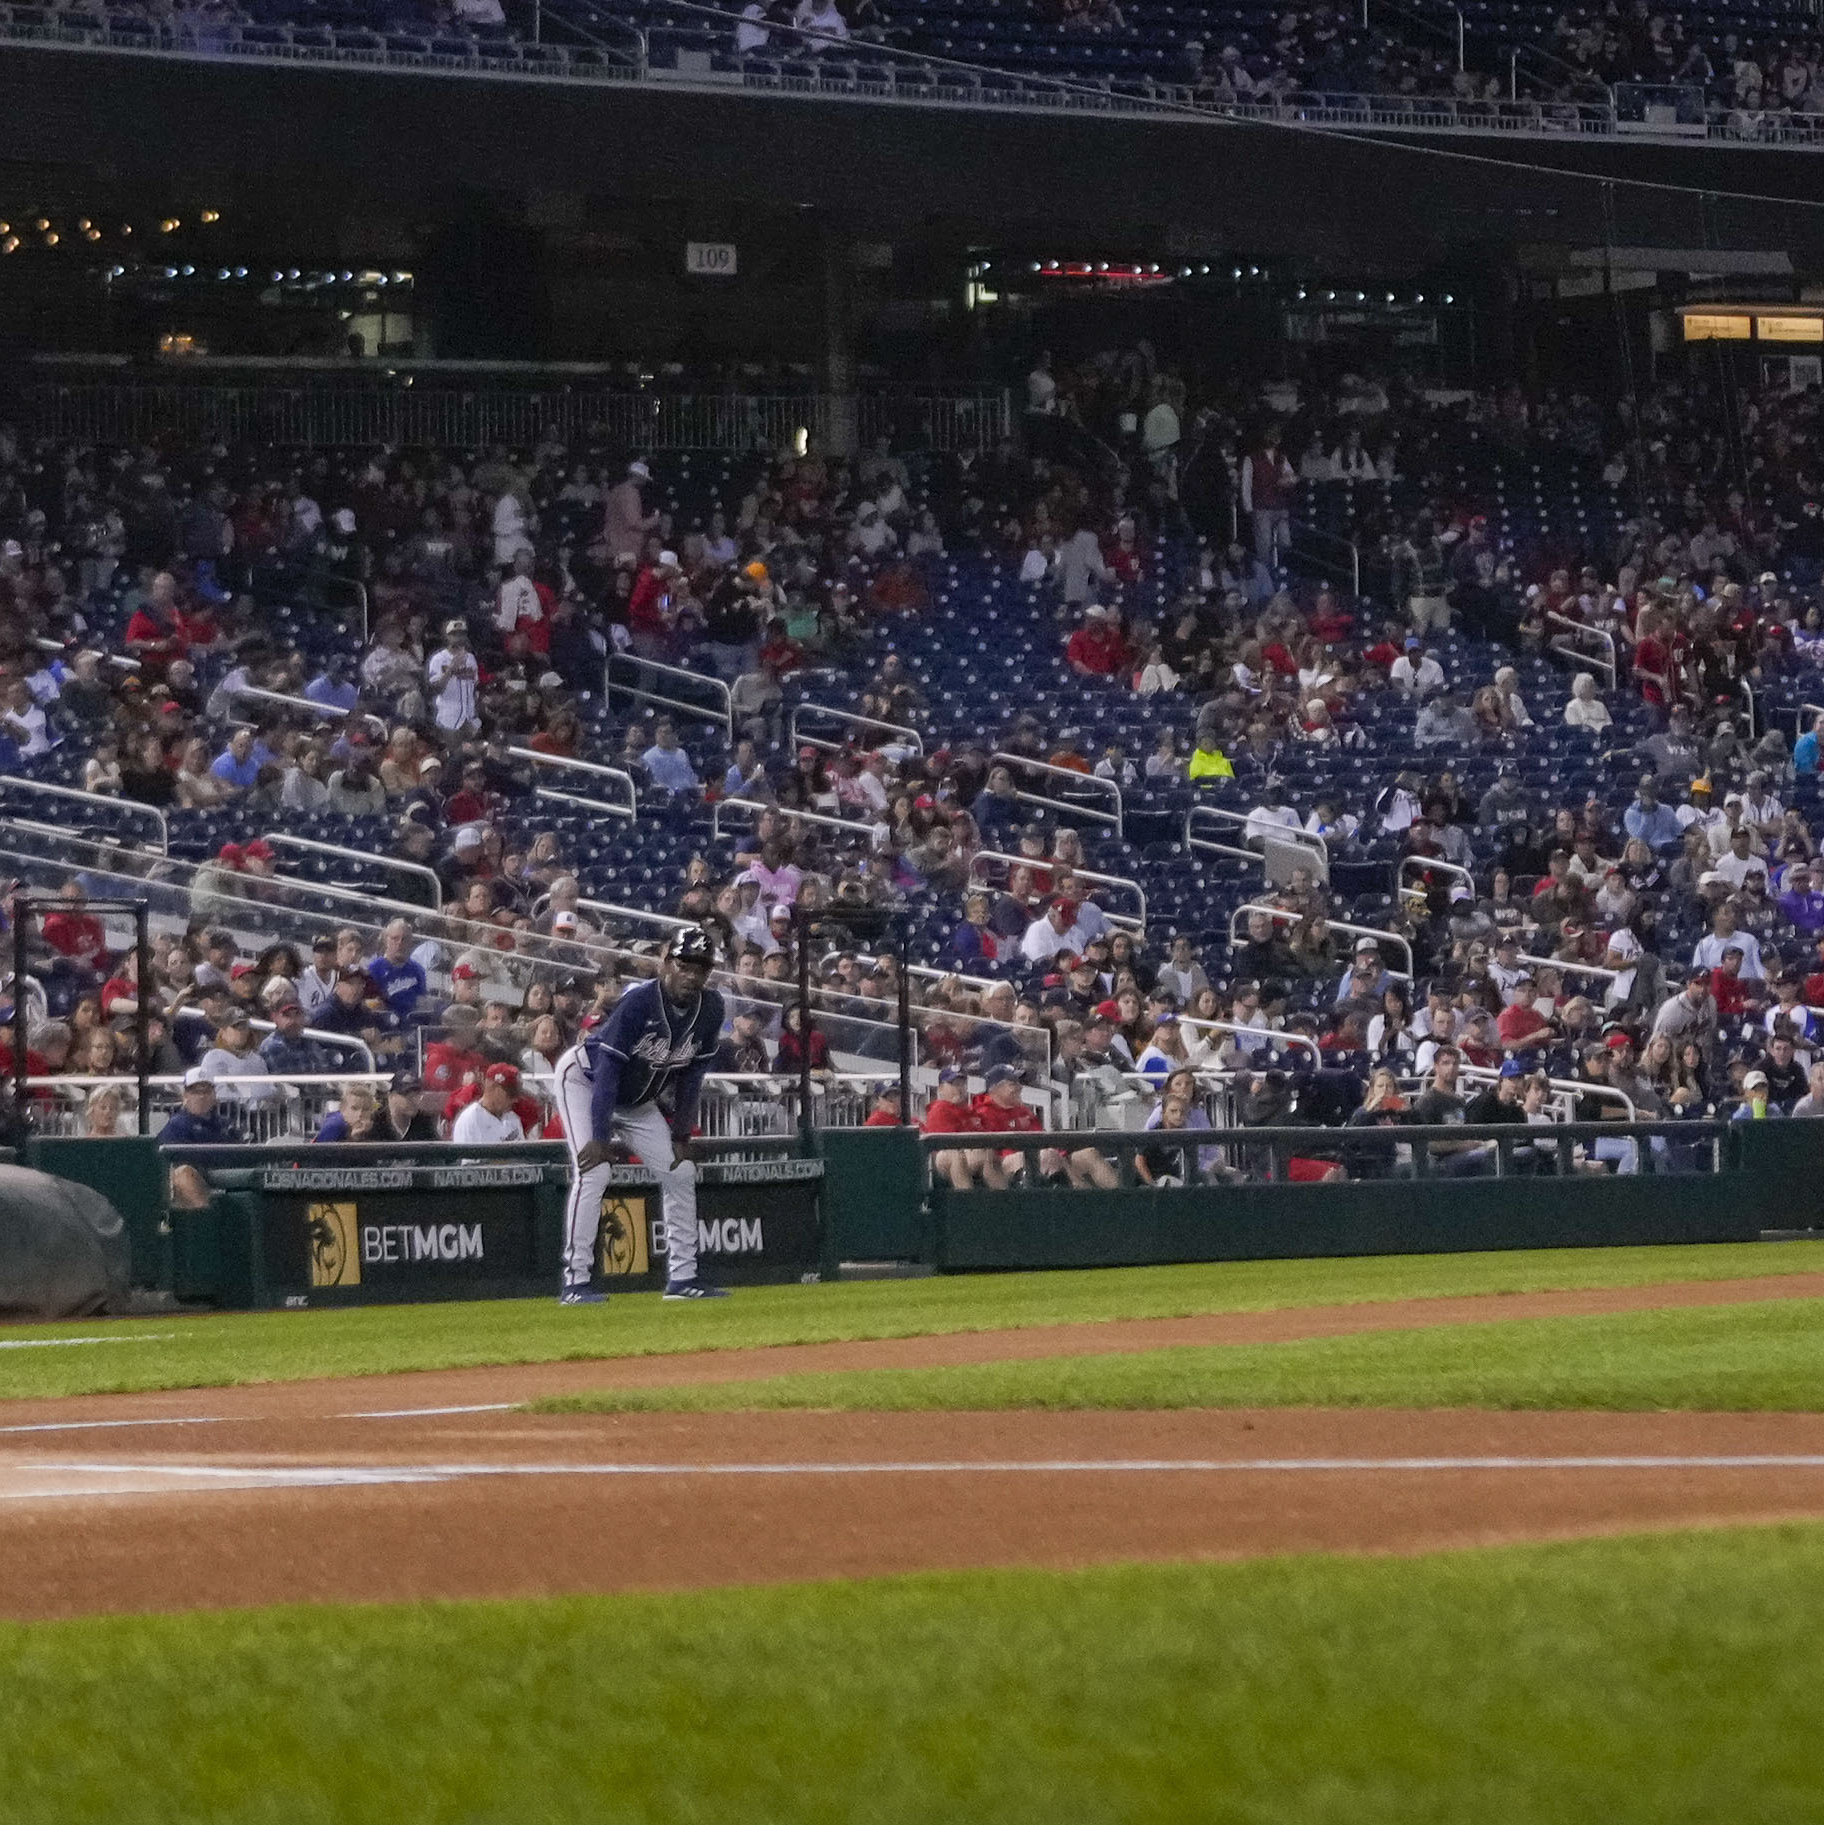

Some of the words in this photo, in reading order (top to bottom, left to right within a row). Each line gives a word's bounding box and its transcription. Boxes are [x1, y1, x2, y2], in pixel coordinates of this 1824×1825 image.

[698, 248, 727, 269] 109
[434, 1167, 543, 1187] NATIONALS.COM
[723, 1160, 825, 1182] NATIONALS.COM
[364, 1224, 483, 1261] BETMGM
[652, 1218, 763, 1255] BMGM
